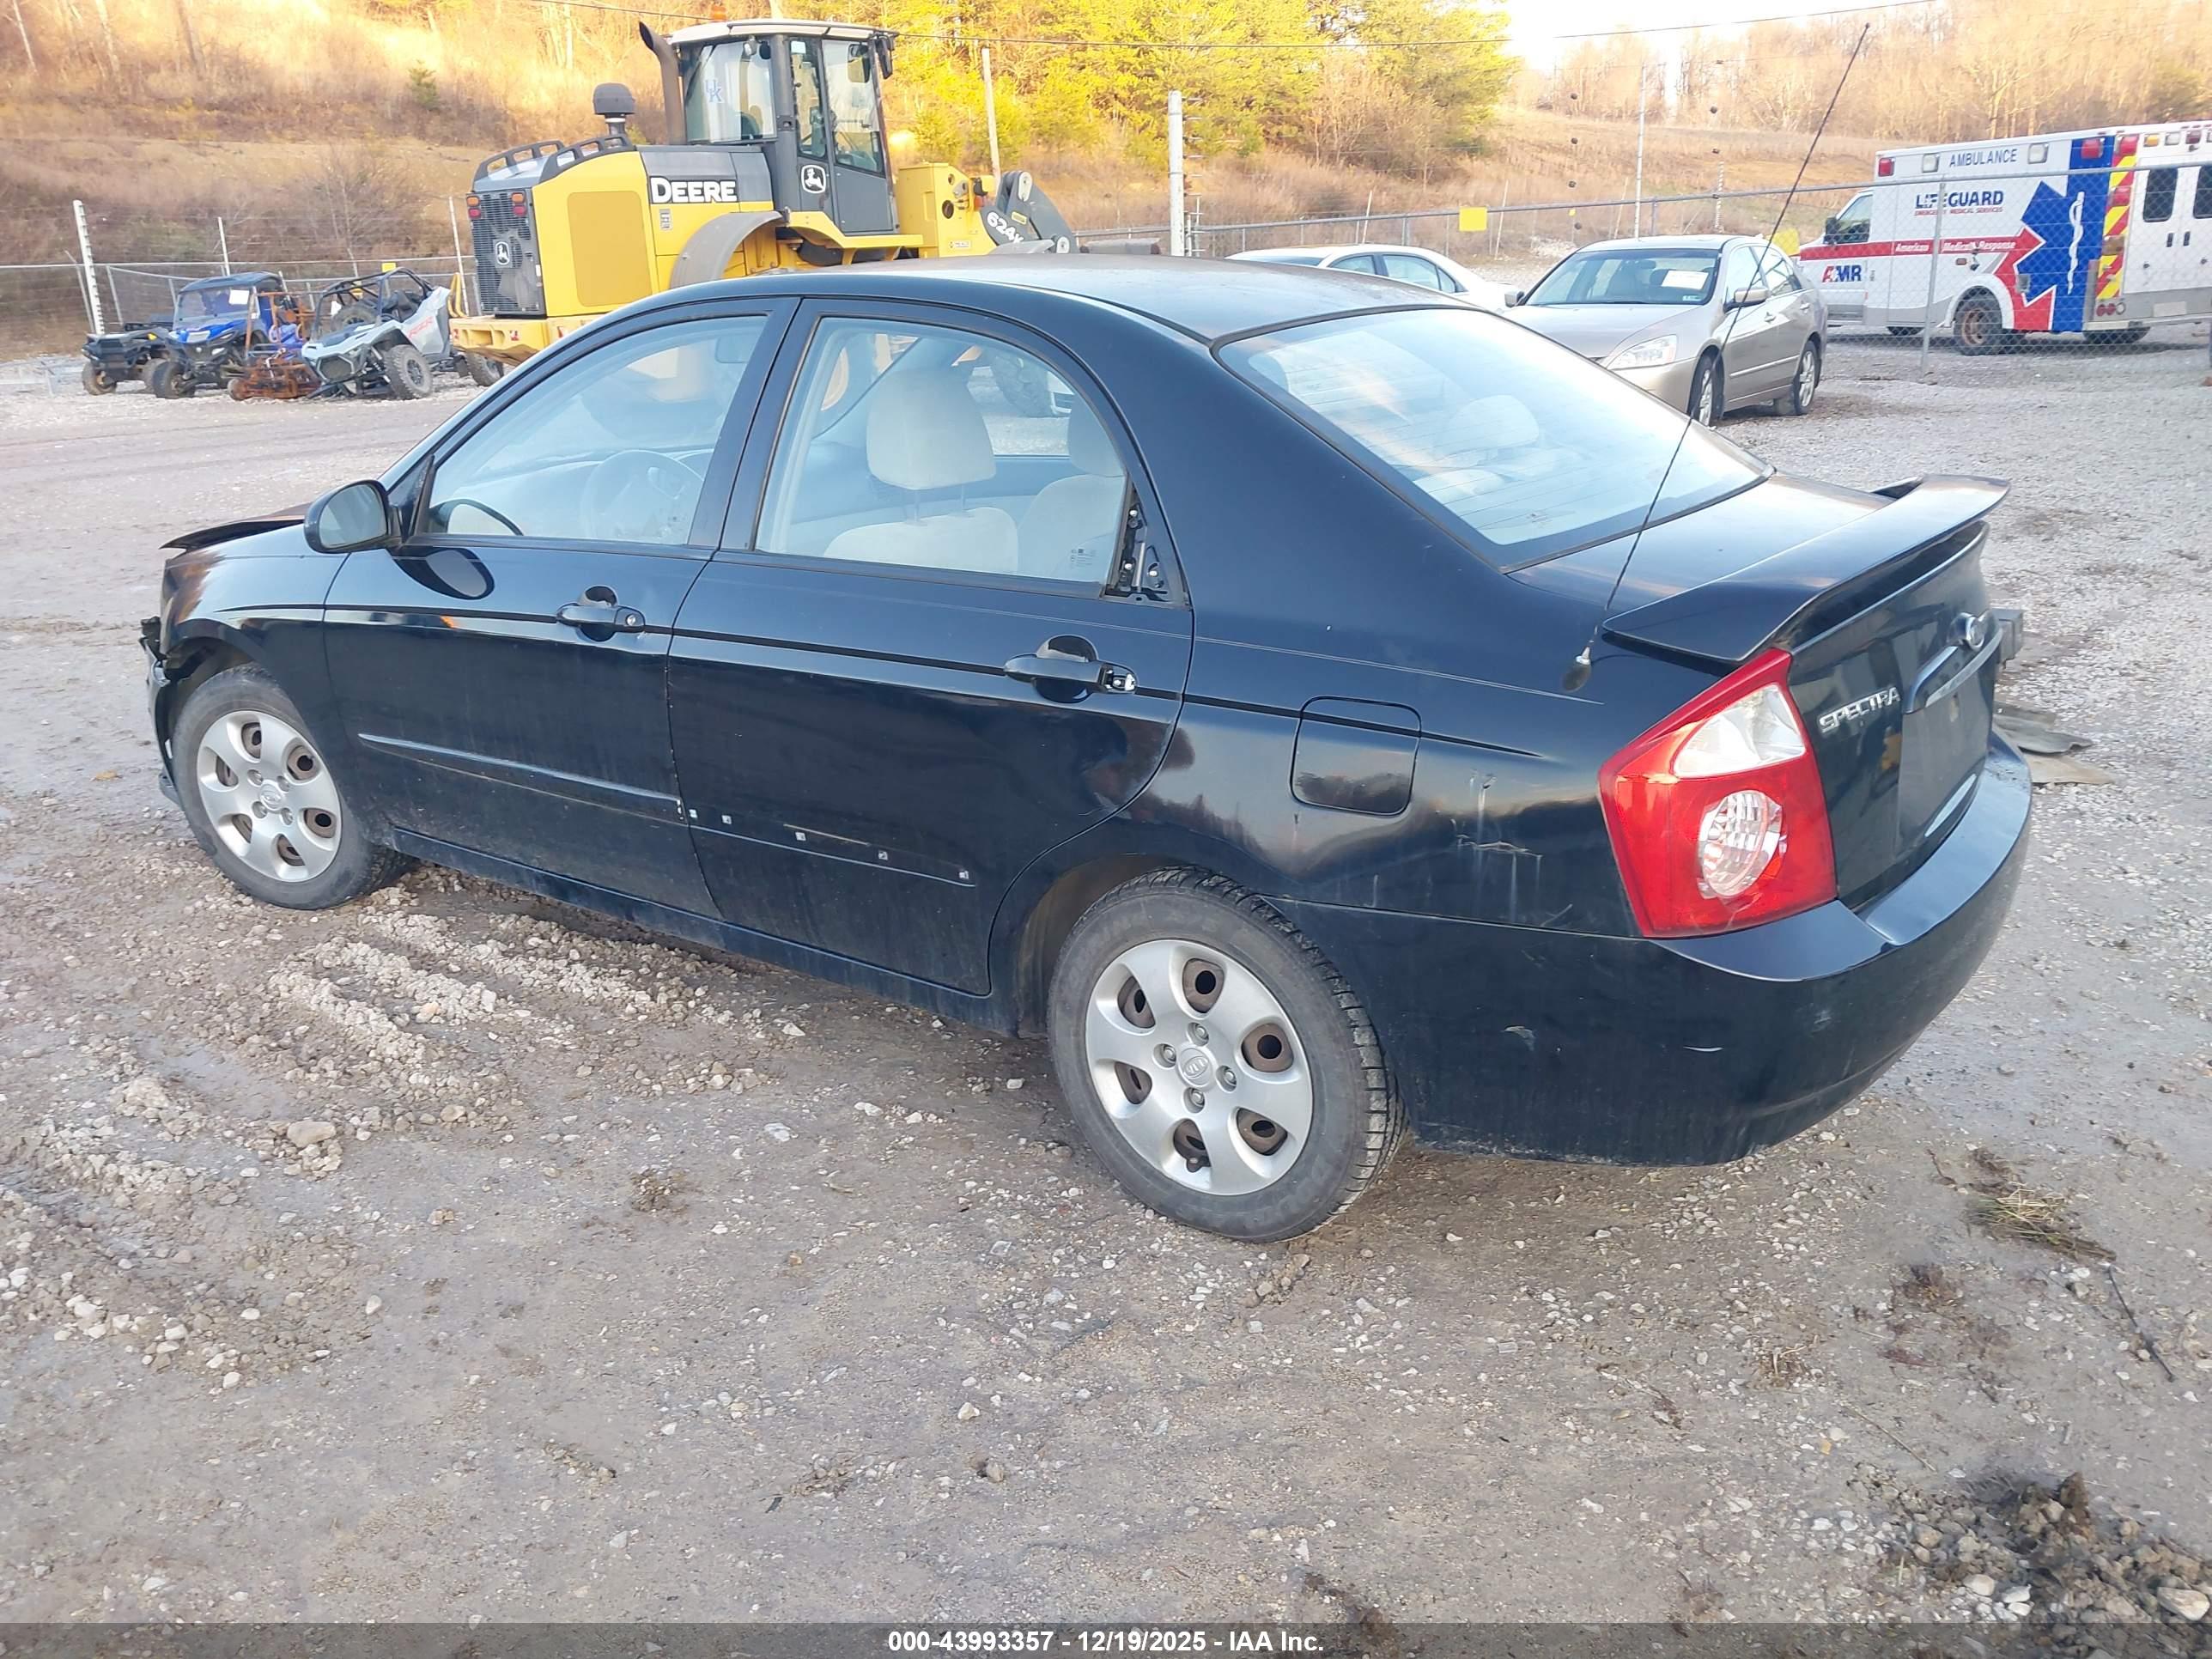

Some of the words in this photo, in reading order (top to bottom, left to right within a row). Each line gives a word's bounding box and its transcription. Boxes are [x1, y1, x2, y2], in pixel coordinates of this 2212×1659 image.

[1948, 148, 2018, 167] AMBULANCE
[650, 176, 738, 204] DEERE
[1821, 264, 1862, 283] AMR
[1820, 687, 1900, 733] SPECTRA
